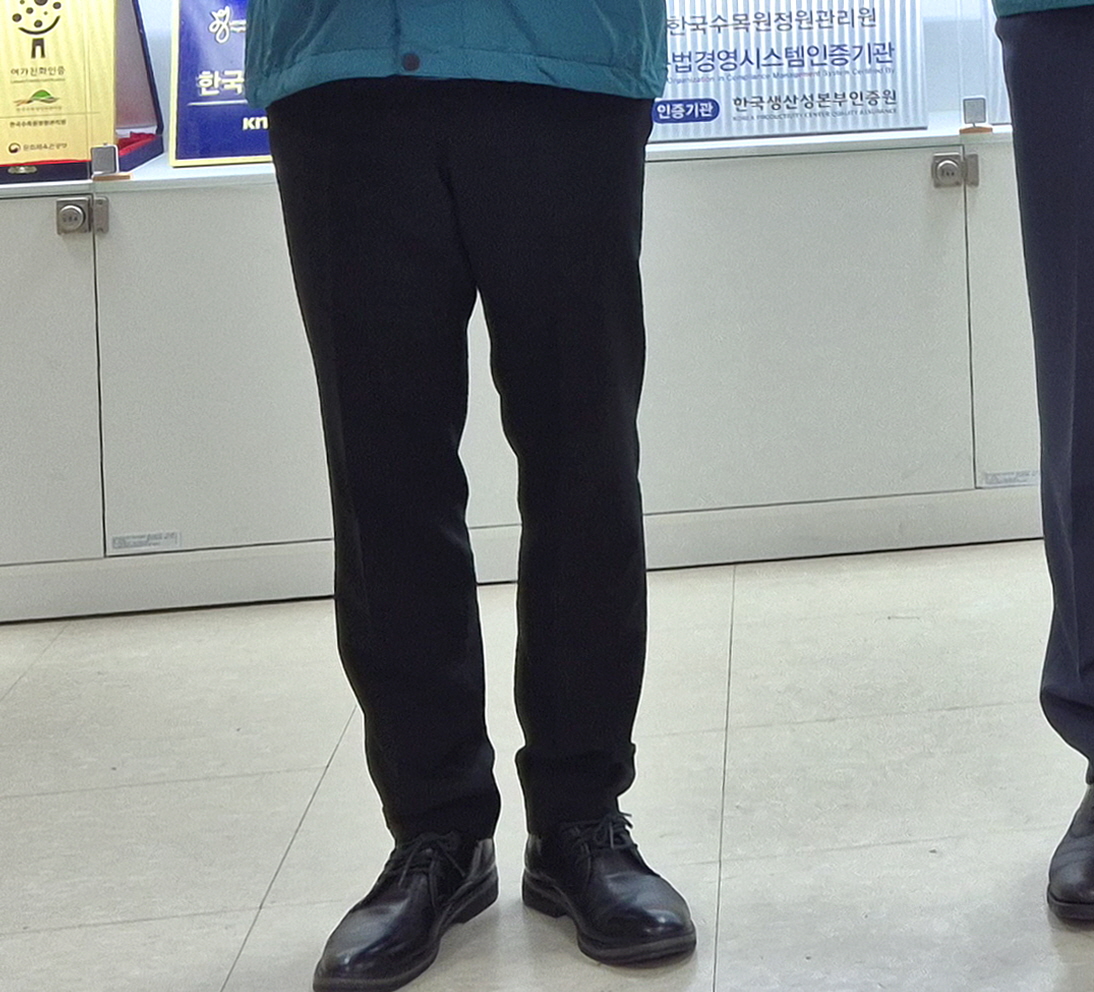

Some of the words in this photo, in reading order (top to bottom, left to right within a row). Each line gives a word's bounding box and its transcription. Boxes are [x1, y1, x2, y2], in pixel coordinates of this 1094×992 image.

[667, 7, 877, 36] 한국수목원정원관리원
[667, 41, 896, 74] 법경영시스템인증기관
[197, 70, 246, 97] 한국
[656, 102, 714, 121] 인증기관
[732, 88, 897, 112] 한국생산성본부인증원
